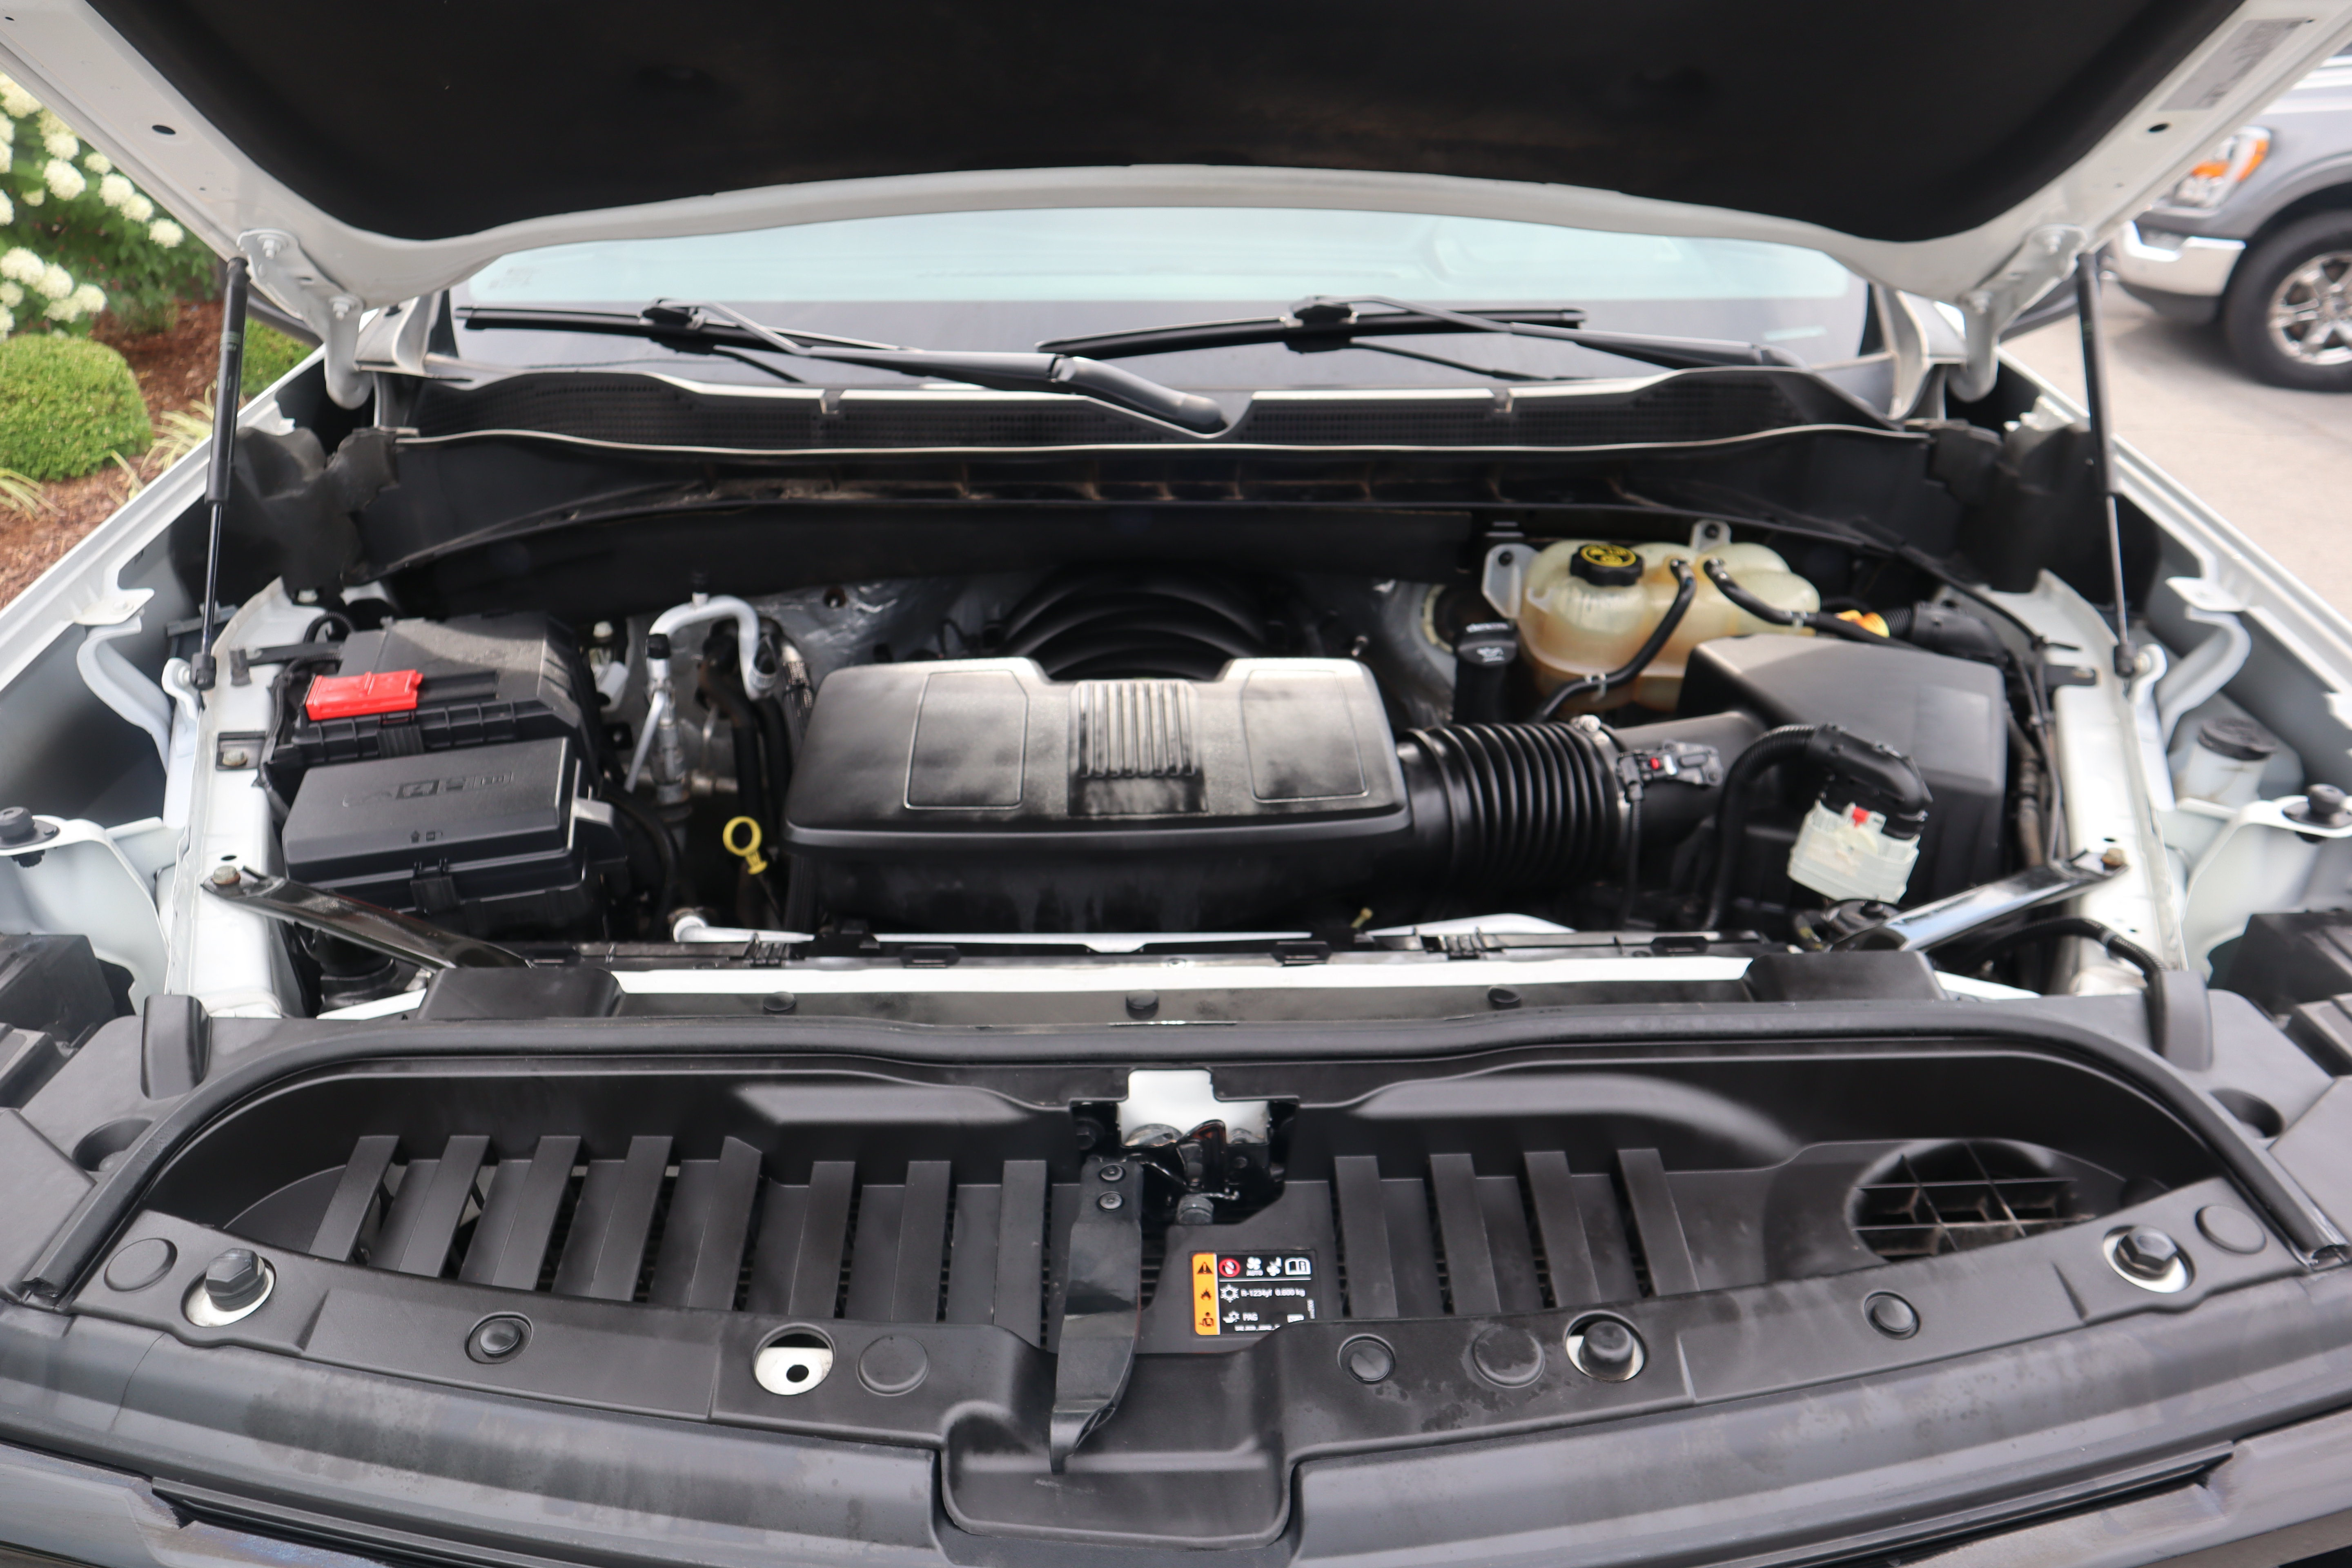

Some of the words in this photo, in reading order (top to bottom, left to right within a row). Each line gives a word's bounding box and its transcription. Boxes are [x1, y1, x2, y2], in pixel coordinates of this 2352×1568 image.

[1241, 1288, 1272, 1298] R-1234yf
[1295, 1287, 1305, 1297] kg
[1243, 1312, 1258, 1321] PAG
